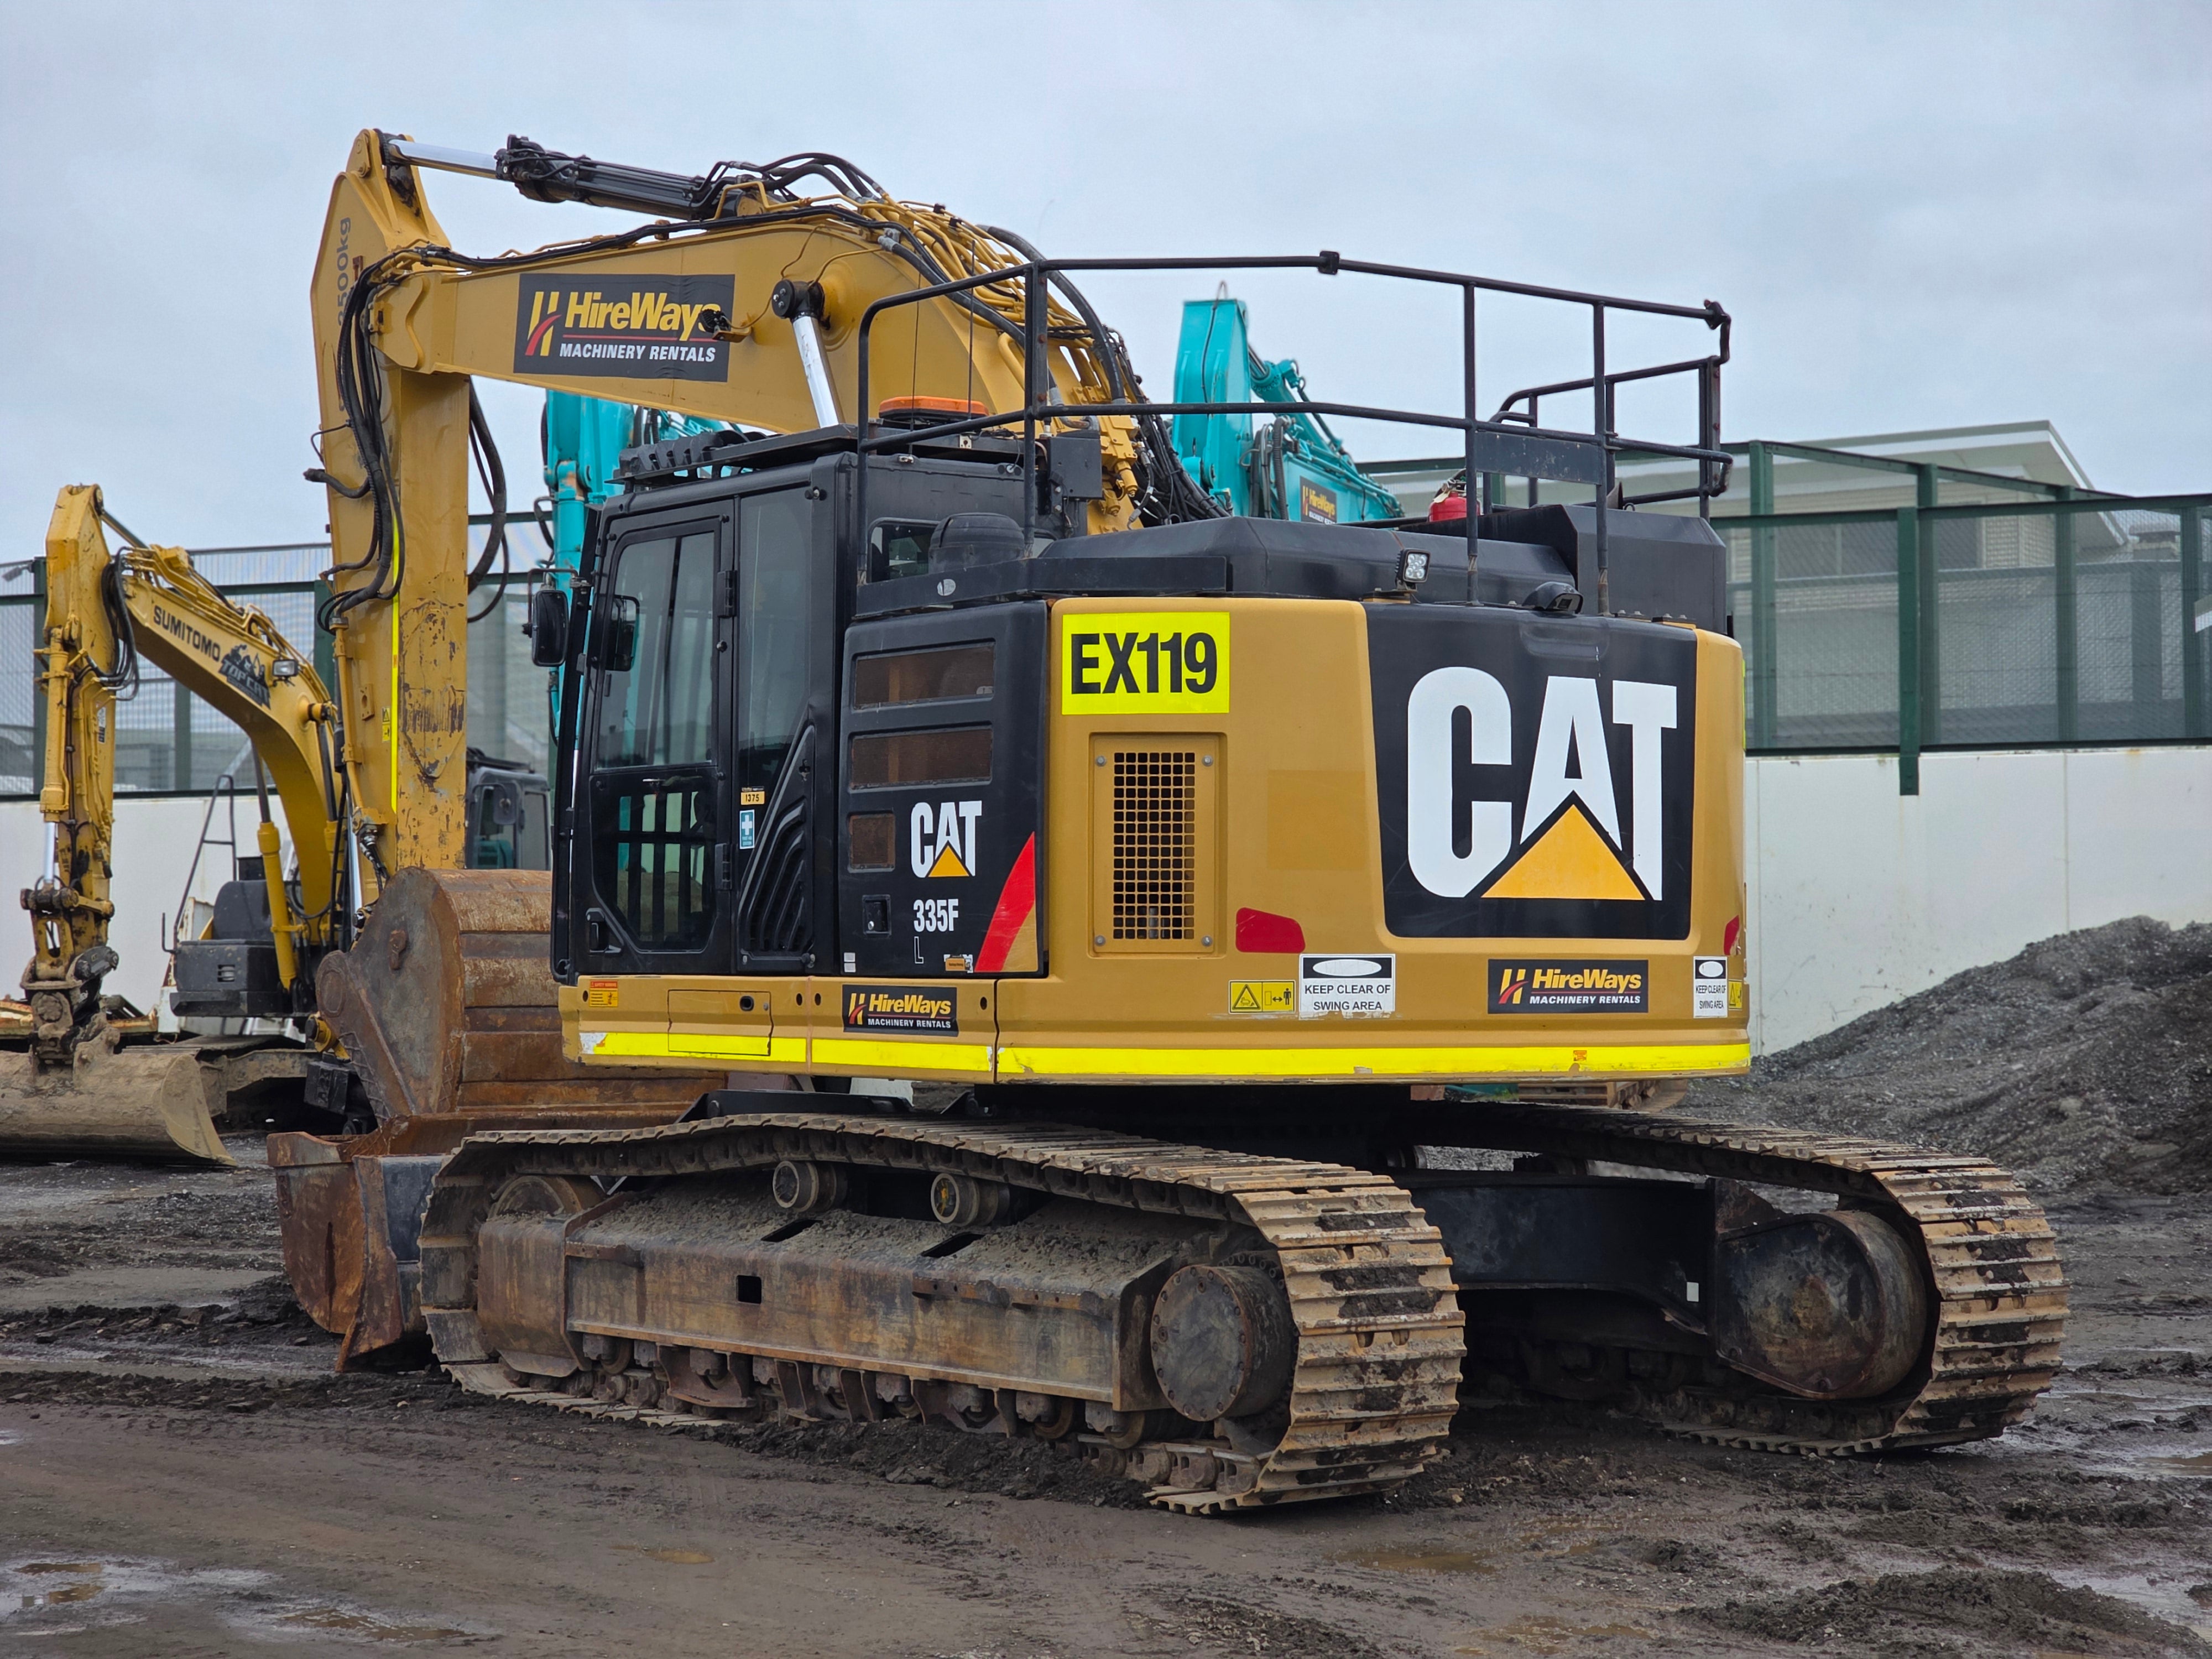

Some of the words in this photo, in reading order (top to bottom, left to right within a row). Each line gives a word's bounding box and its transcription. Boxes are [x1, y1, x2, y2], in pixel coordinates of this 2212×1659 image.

[559, 343, 646, 360] MACHINERY
[649, 346, 716, 363] RENTALS
[153, 605, 221, 662] SUMITOMO
[1071, 632, 1217, 694] EX119
[221, 659, 247, 683] TOP
[246, 675, 270, 708] CAT
[1407, 666, 1677, 901] CAT
[745, 794, 760, 802] 1375
[911, 800, 982, 878] CAT
[913, 899, 958, 932] 335F
[914, 936, 924, 964] L
[1305, 985, 1334, 994] KEEP
[1337, 985, 1374, 994] CLEAR
[1376, 985, 1391, 994] OF
[1532, 969, 1641, 994] HireWays
[1695, 985, 1708, 994] KEEP
[1708, 985, 1721, 994] CLEAR
[1721, 985, 1726, 994] OF
[869, 994, 951, 1018] HireWays
[1313, 1001, 1349, 1010] SWING
[1353, 1001, 1383, 1010] AREA
[1699, 1000, 1713, 1009] SWING
[1714, 1000, 1724, 1009] AREA
[868, 1018, 913, 1027] MACHINERY
[916, 1020, 951, 1029] RENTALS
